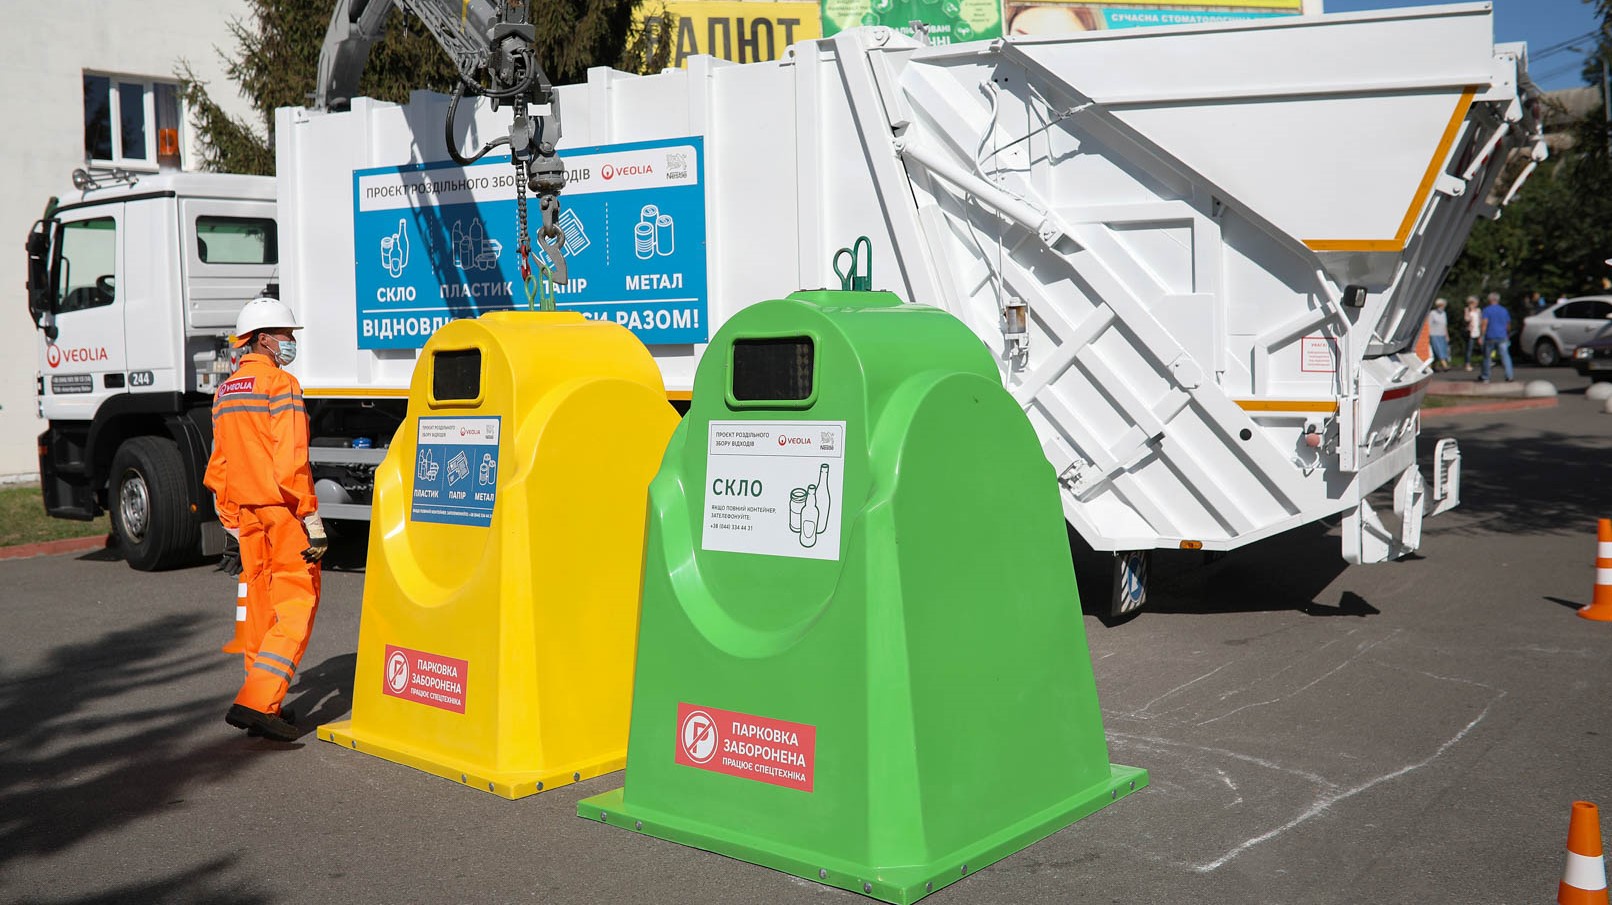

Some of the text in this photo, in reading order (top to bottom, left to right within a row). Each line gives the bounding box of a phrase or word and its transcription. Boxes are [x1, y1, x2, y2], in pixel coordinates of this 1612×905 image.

[616, 164, 653, 176] VEOLIA
[366, 184, 409, 198] ПРОЄКТ
[411, 177, 489, 195] РОЗДІЛЬНОГО
[440, 281, 513, 299] ПЛАСТИК
[625, 273, 683, 291] МЕТАЛ
[376, 286, 417, 302] СКЛО
[616, 308, 699, 330] РАЗОМ!
[62, 347, 108, 362] VEOLIA
[132, 373, 150, 385] 244
[226, 381, 252, 392] VEOLIA
[413, 489, 439, 498] ПЛАСТИК
[448, 491, 467, 500] ПАПІР
[712, 478, 763, 497] СКЛО
[474, 492, 495, 502] МЕТАЛ
[417, 659, 458, 678] ПАРКОВКА
[411, 673, 462, 694] ЗАБОРОНЕНА
[732, 722, 799, 746] ПАРКОВКА
[723, 739, 806, 767] ЗАБОРОНЕНА
[722, 757, 806, 782] ПРАЦЮЄ СПЕЦТЕХНІКА
